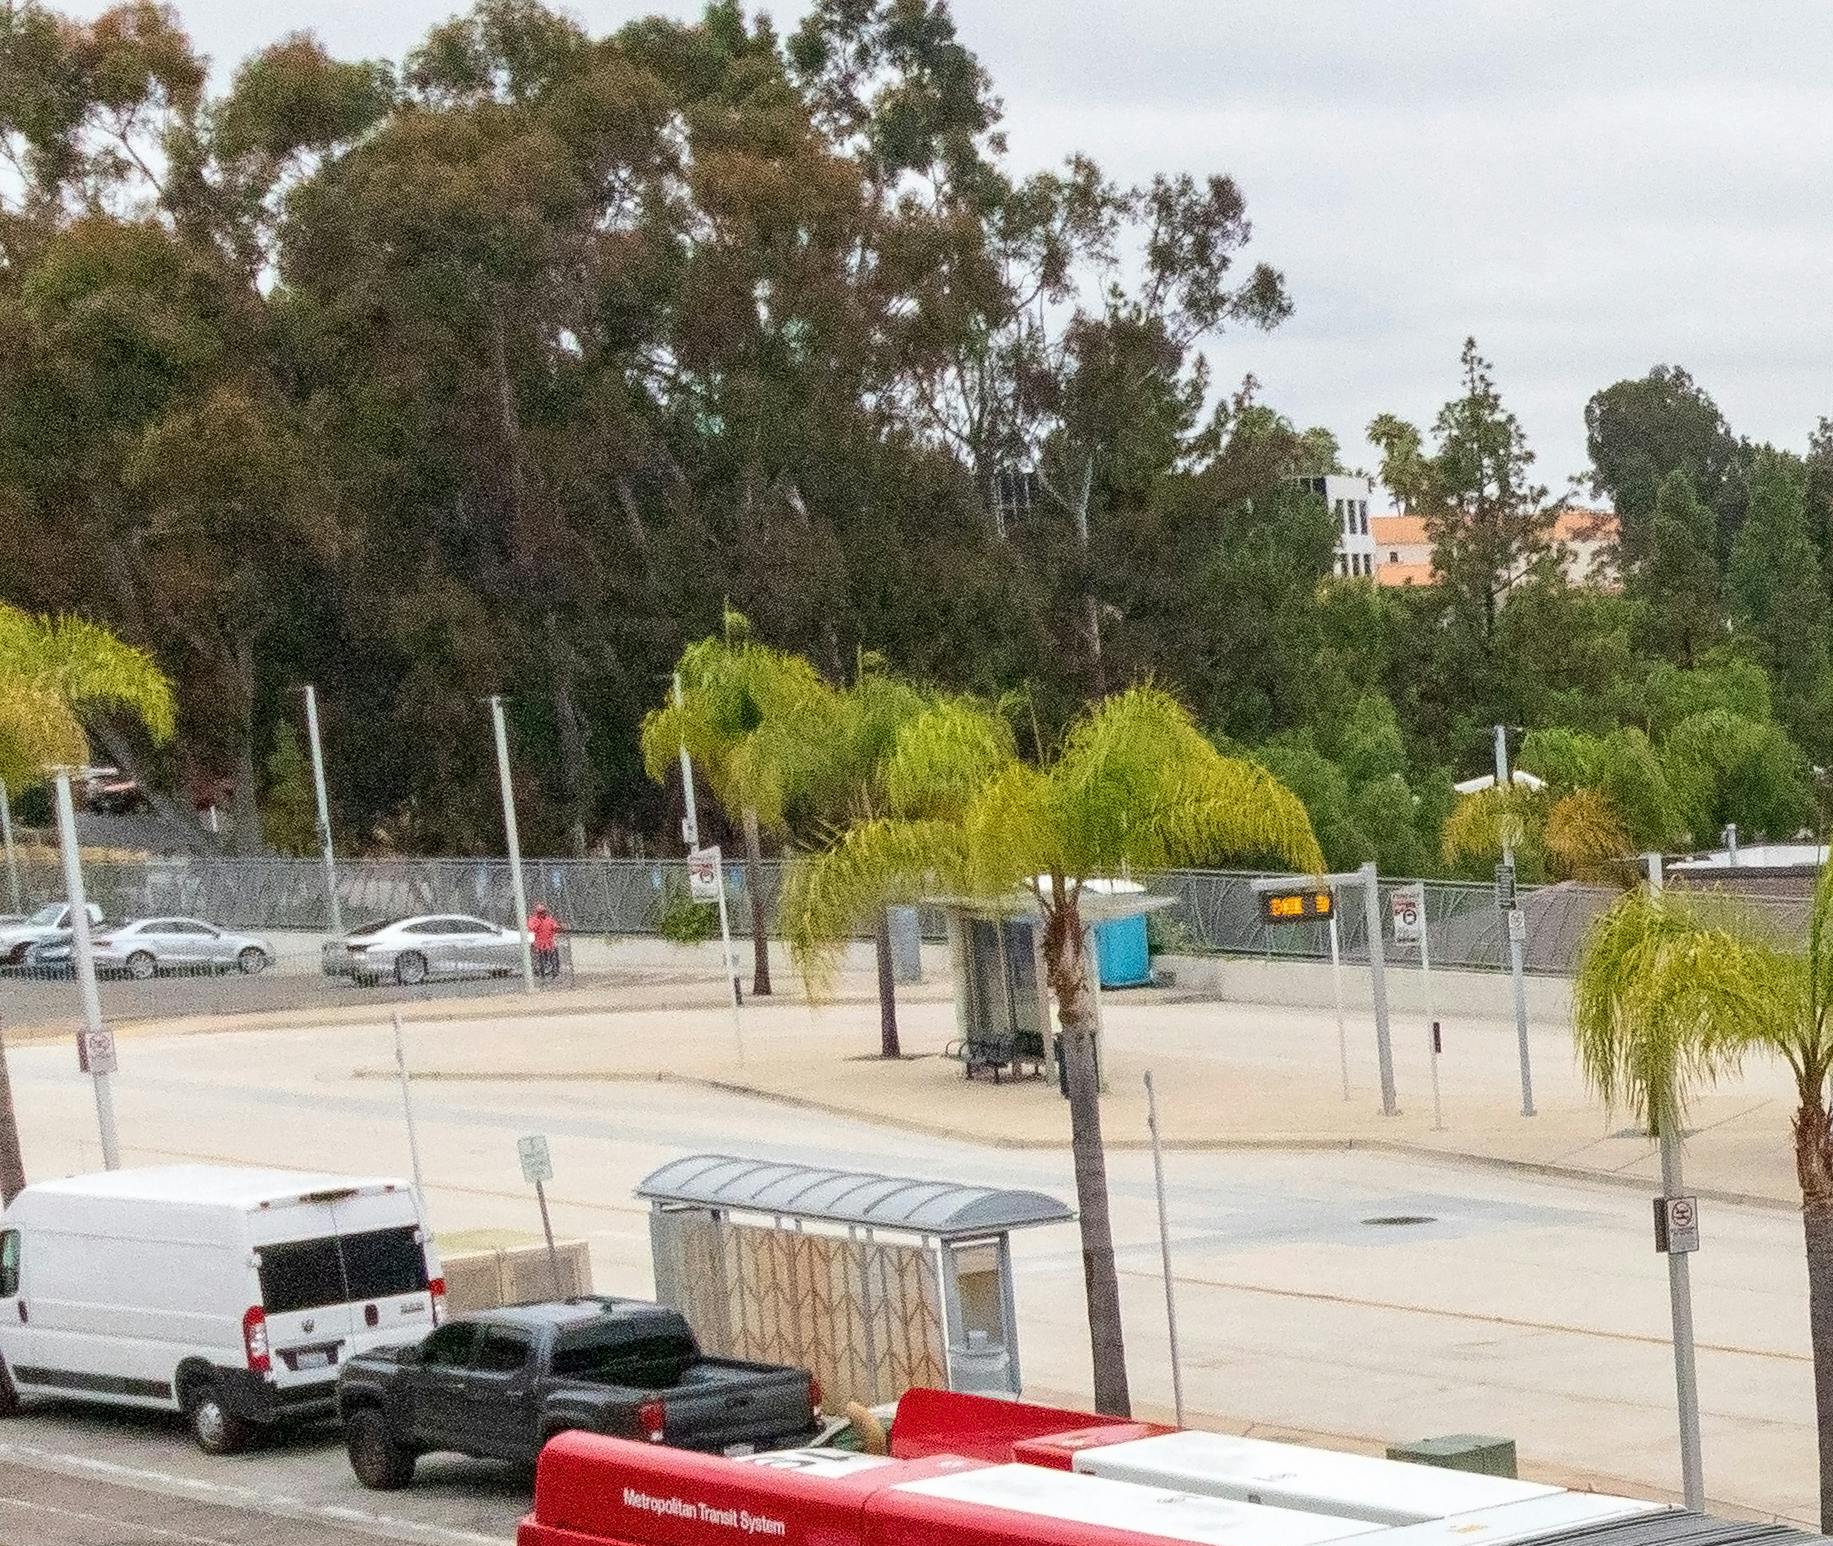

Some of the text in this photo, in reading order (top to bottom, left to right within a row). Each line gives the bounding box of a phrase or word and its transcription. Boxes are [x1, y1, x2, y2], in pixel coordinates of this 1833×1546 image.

[623, 1487, 786, 1536] Metropolitan Transit System
